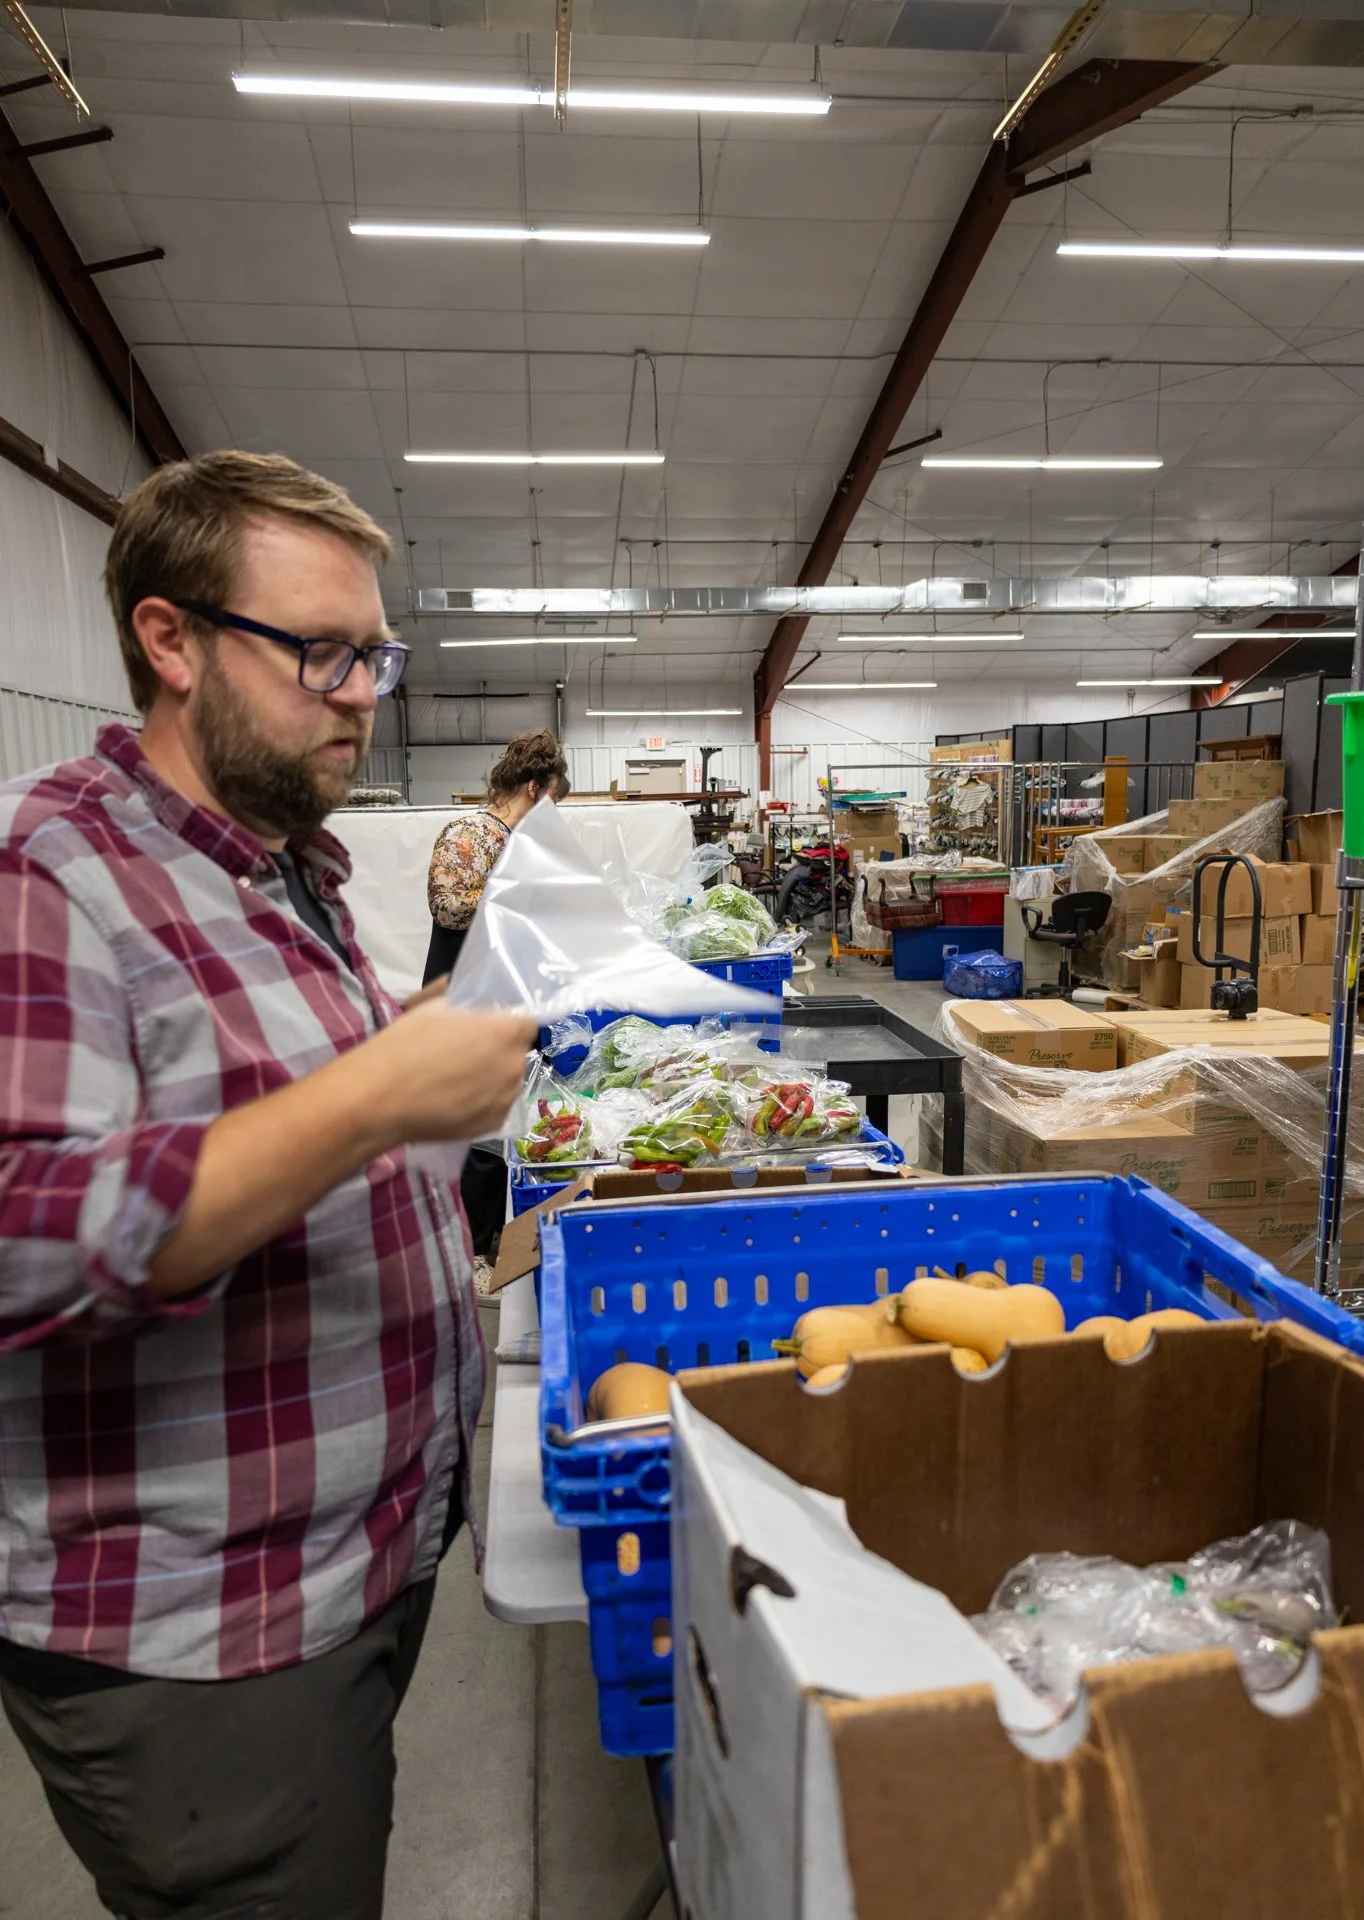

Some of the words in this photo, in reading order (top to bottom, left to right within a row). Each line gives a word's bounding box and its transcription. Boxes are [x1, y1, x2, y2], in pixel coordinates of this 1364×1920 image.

[649, 738, 663, 748] EXIT
[1094, 1033, 1113, 1041] 2750
[1028, 1048, 1074, 1061] Preserve
[1119, 1153, 1188, 1173] Preserve
